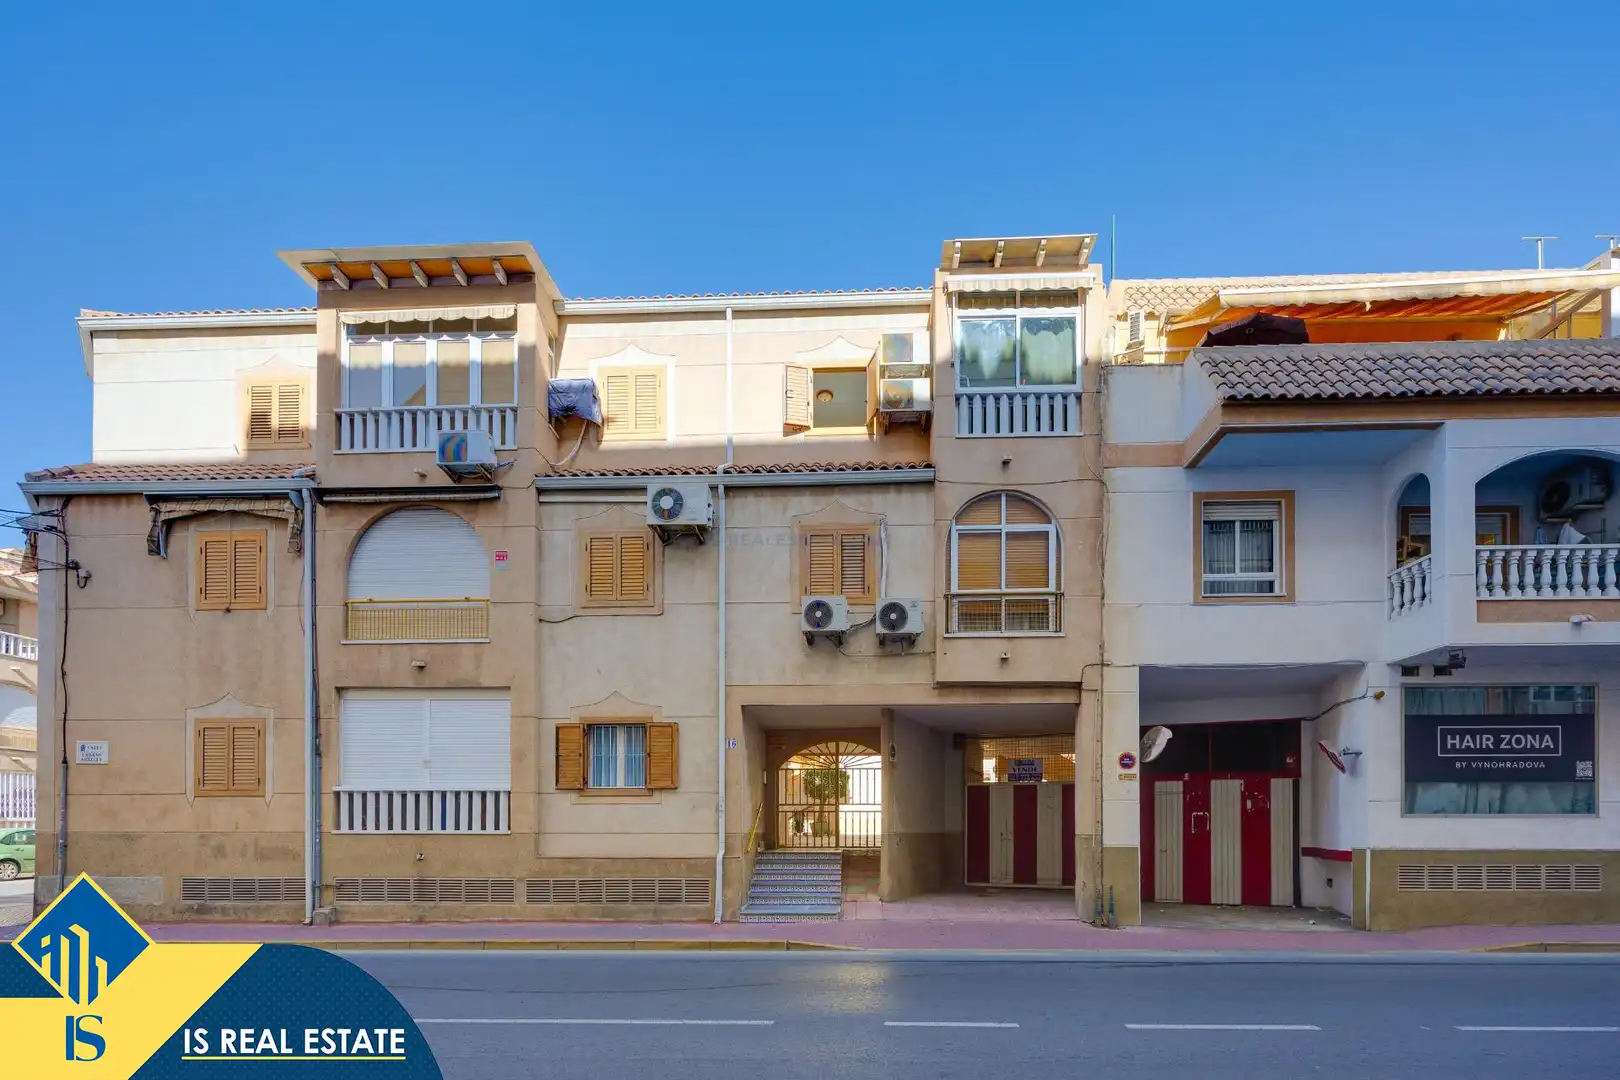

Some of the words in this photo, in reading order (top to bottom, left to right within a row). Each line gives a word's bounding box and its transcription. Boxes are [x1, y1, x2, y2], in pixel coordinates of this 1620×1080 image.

[1447, 734, 1494, 749] HAIR
[1499, 734, 1555, 749] ZONA
[1455, 761, 1467, 769] BY
[1471, 761, 1546, 769] VYNOHRADOVA
